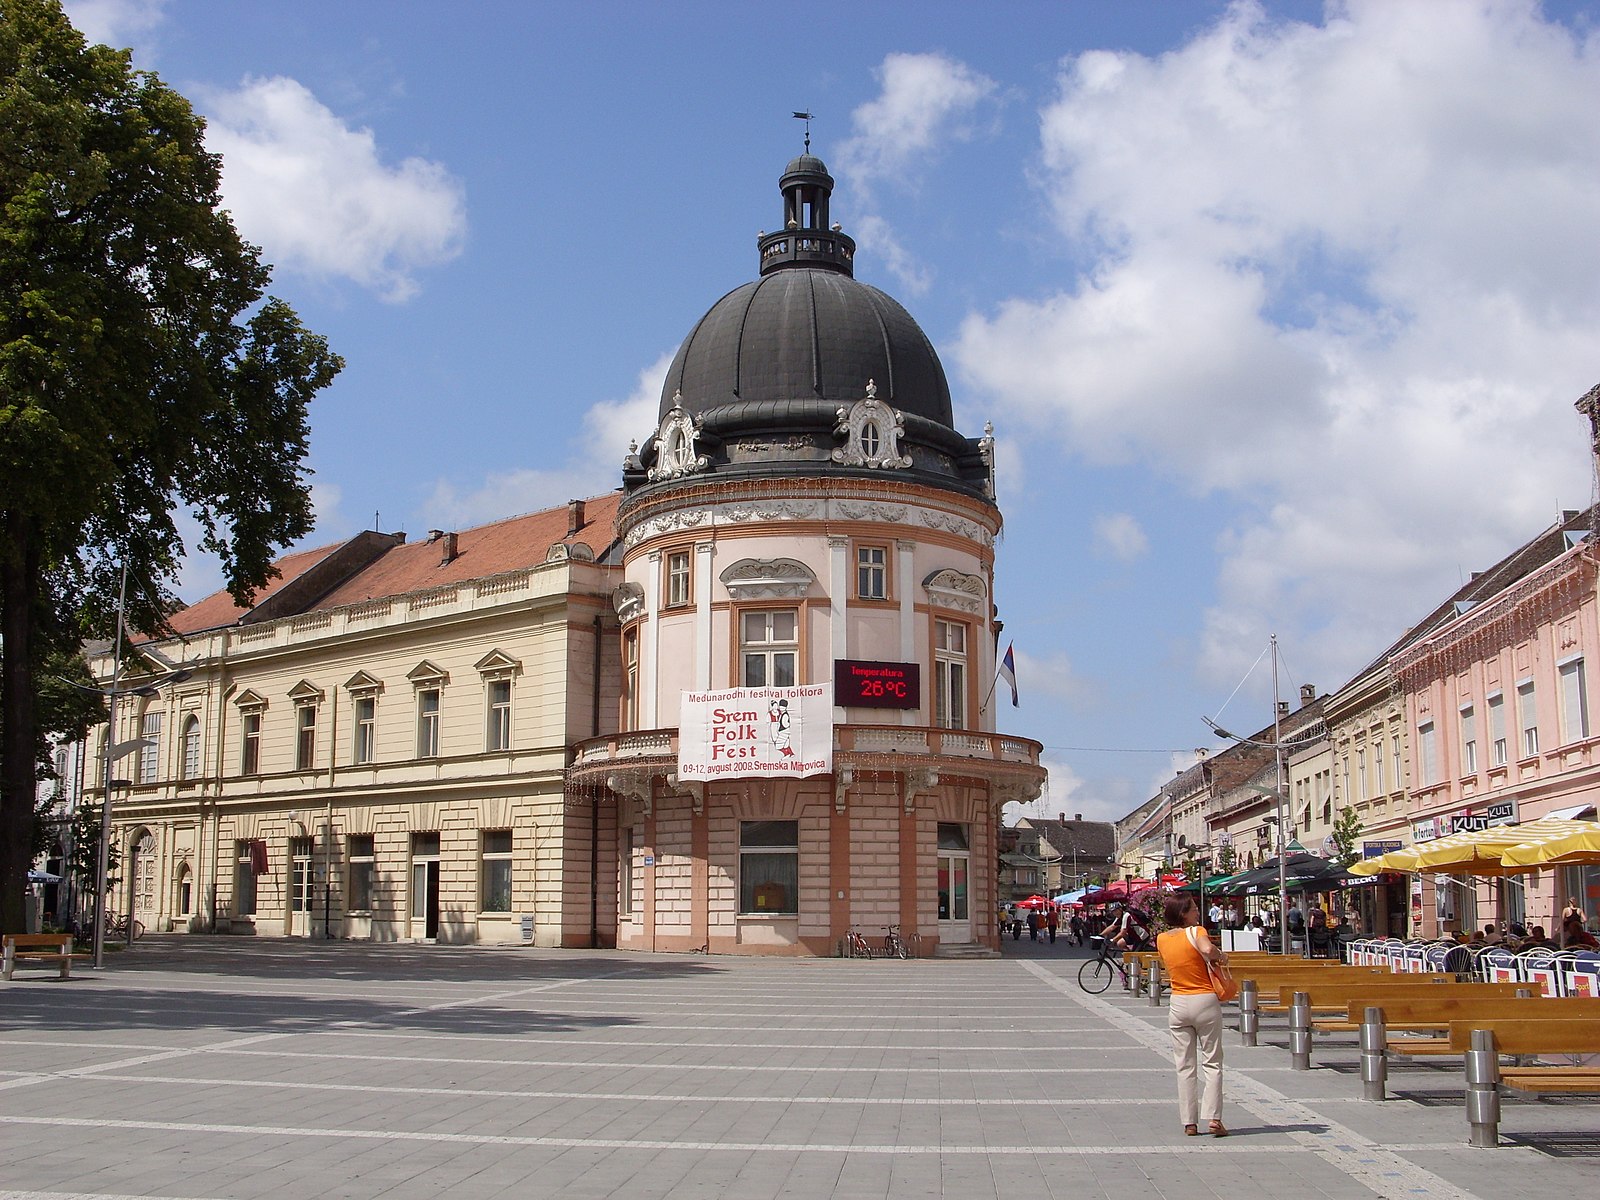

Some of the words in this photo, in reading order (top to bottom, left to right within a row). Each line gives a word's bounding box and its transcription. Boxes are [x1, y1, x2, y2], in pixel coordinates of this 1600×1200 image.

[851, 666, 904, 677] Temperatura
[750, 689, 783, 698] festival
[787, 688, 823, 698] folklora
[712, 708, 758, 724] Srem
[712, 724, 757, 742] Folk
[711, 744, 757, 760] Fest
[707, 763, 732, 774] avgust
[790, 760, 826, 772] Mitrovica
[1488, 804, 1511, 818] KULT
[1453, 817, 1487, 832] KULT
[1418, 827, 1435, 839] fortun
